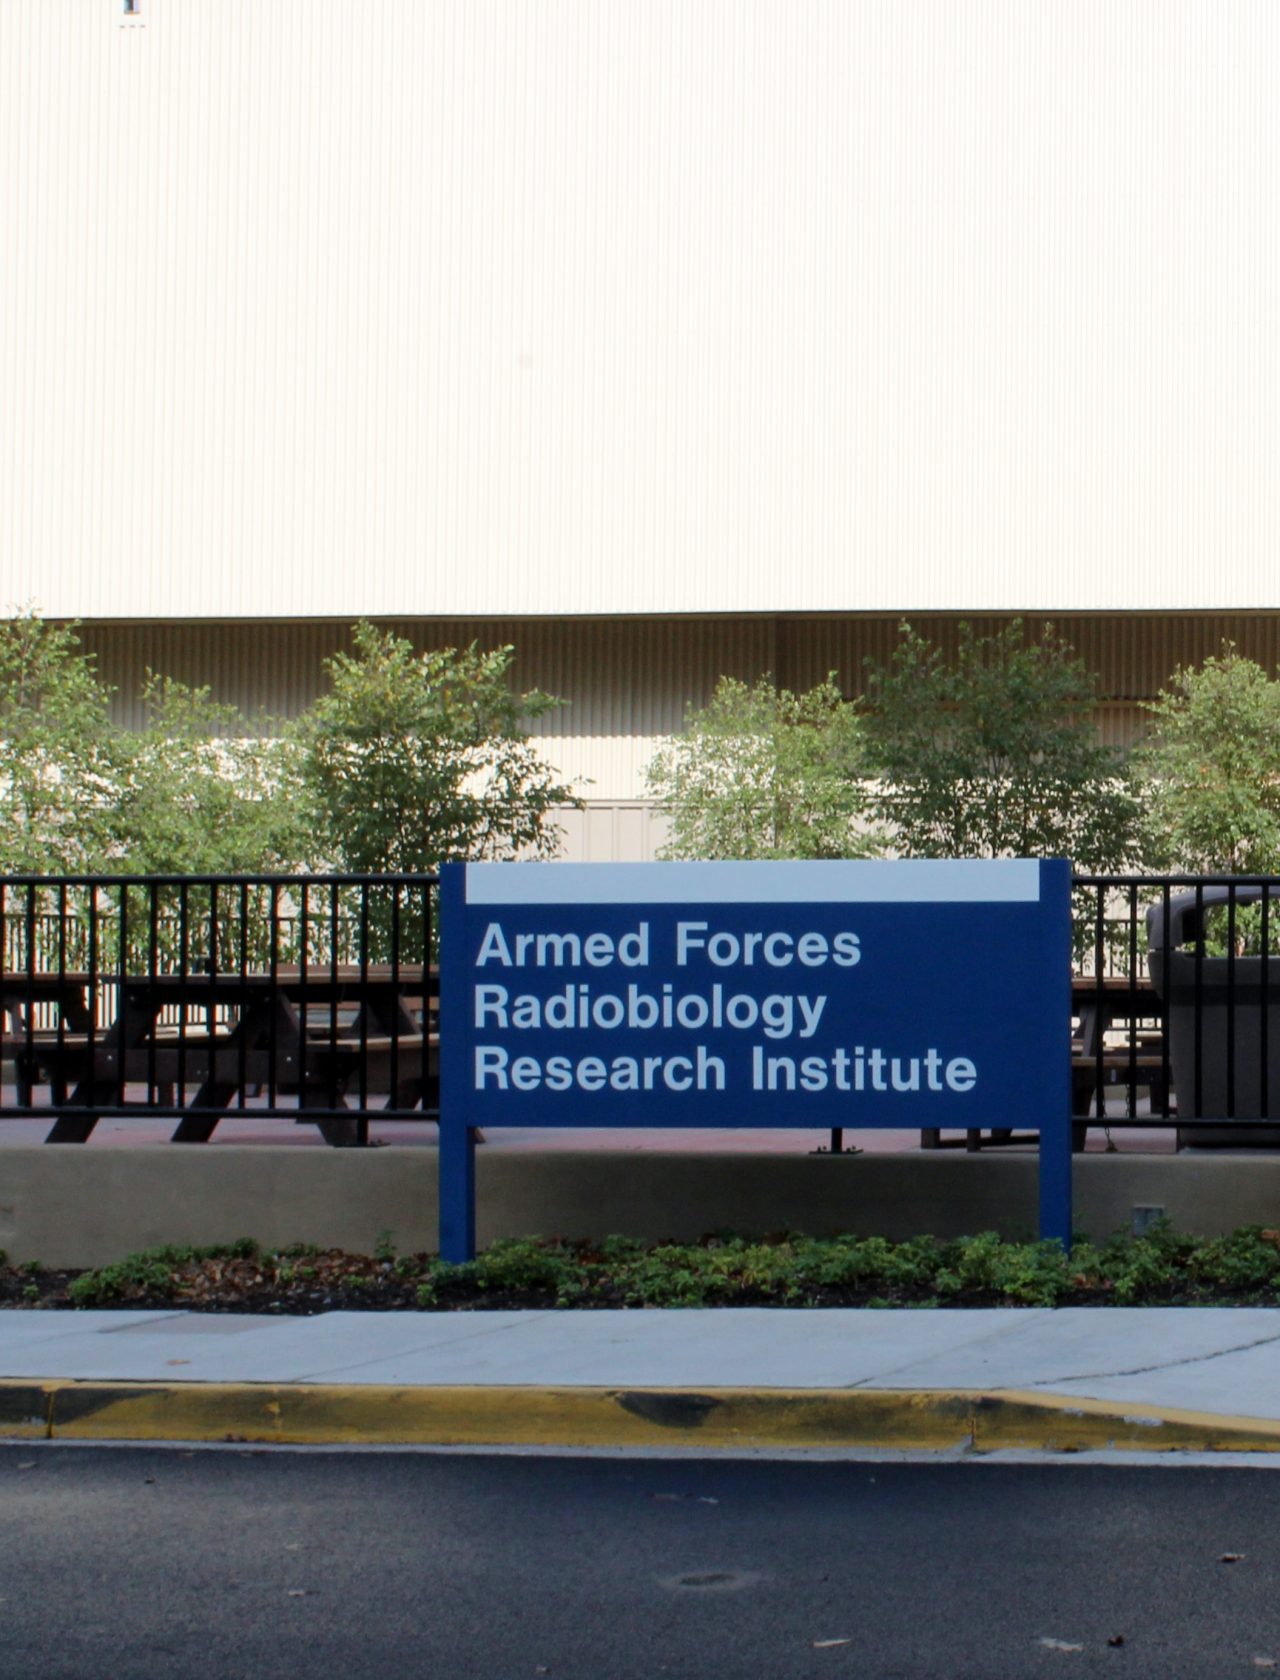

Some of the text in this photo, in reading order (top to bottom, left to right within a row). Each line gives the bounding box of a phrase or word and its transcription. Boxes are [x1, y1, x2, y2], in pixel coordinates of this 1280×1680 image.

[475, 921, 862, 968] Armed Forces
[474, 983, 828, 1039] Radiobiology
[474, 1045, 978, 1092] Research Institute
